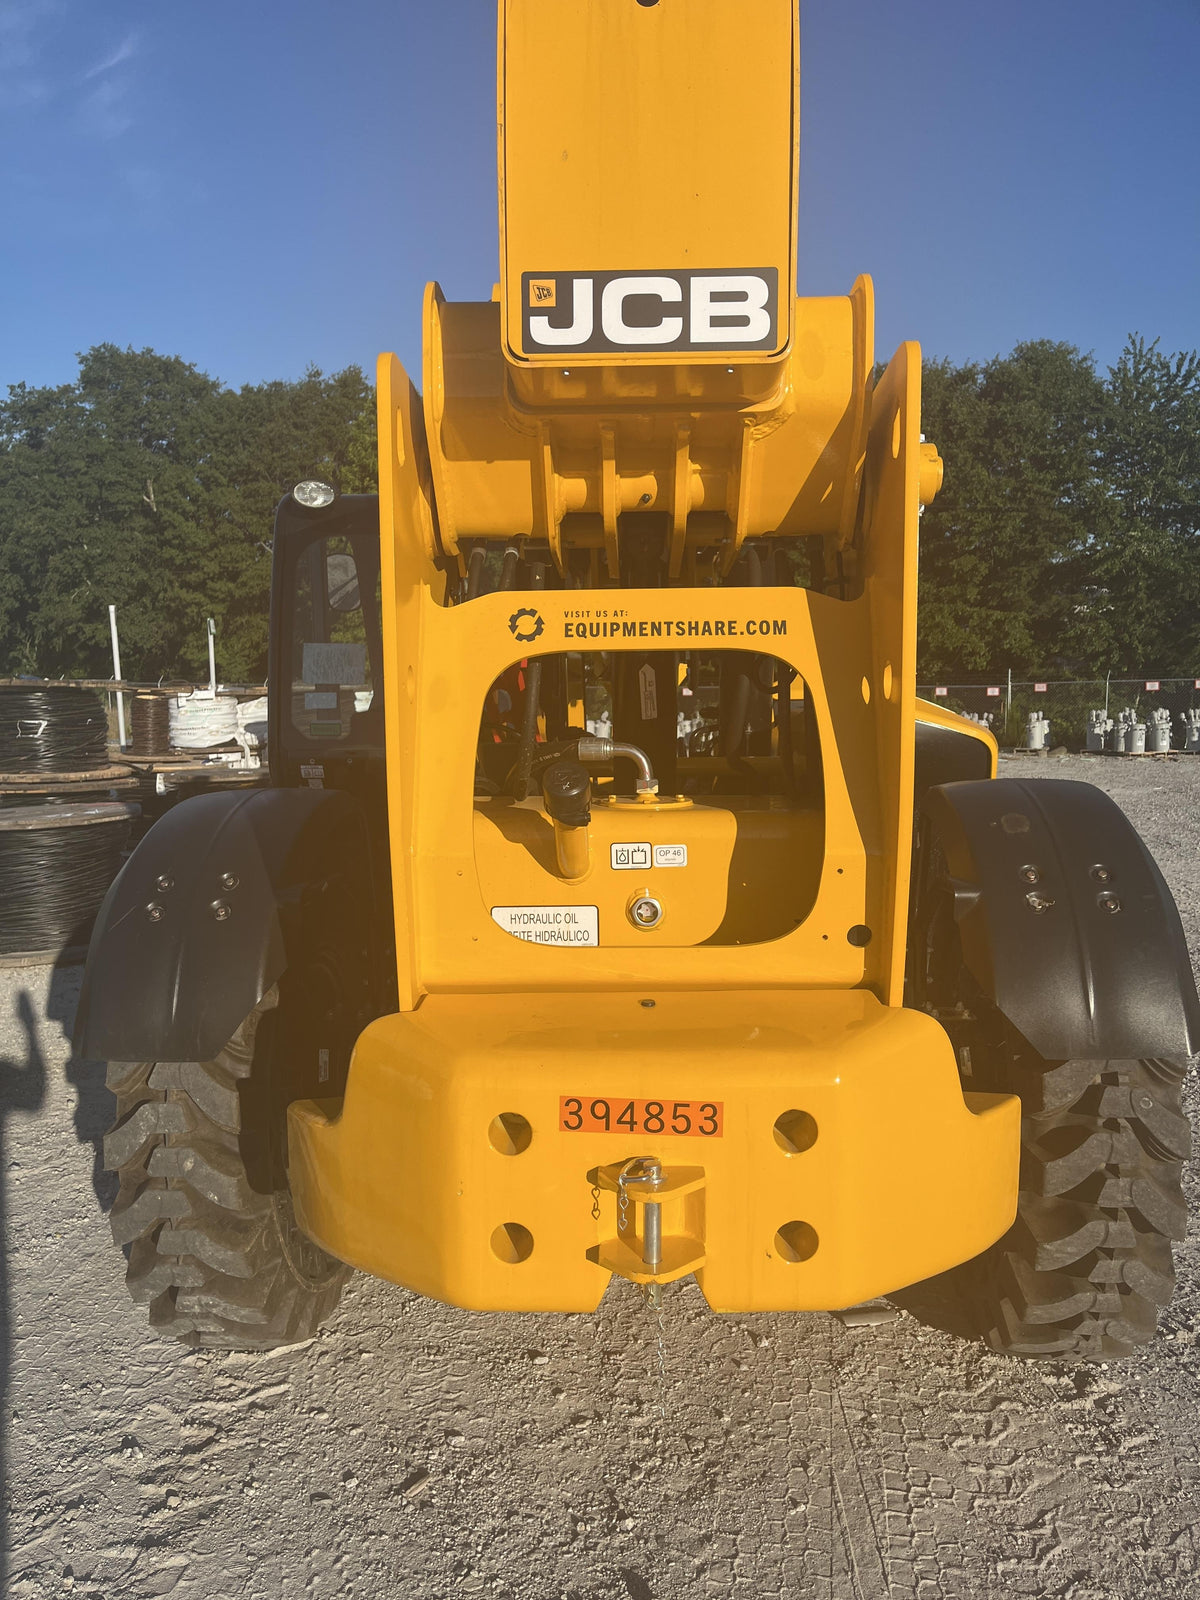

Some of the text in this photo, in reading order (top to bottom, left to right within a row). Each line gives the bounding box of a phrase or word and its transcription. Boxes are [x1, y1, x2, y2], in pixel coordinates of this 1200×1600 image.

[535, 286, 552, 300] JCB
[529, 276, 771, 346] JCB
[564, 620, 787, 639] EQUIPMENTSHARE.COM
[658, 849, 682, 857] OP 46
[510, 913, 579, 924] HYDRAULIC OIL
[535, 928, 589, 942] HIDRÁULICO
[563, 1098, 718, 1136] 394853
